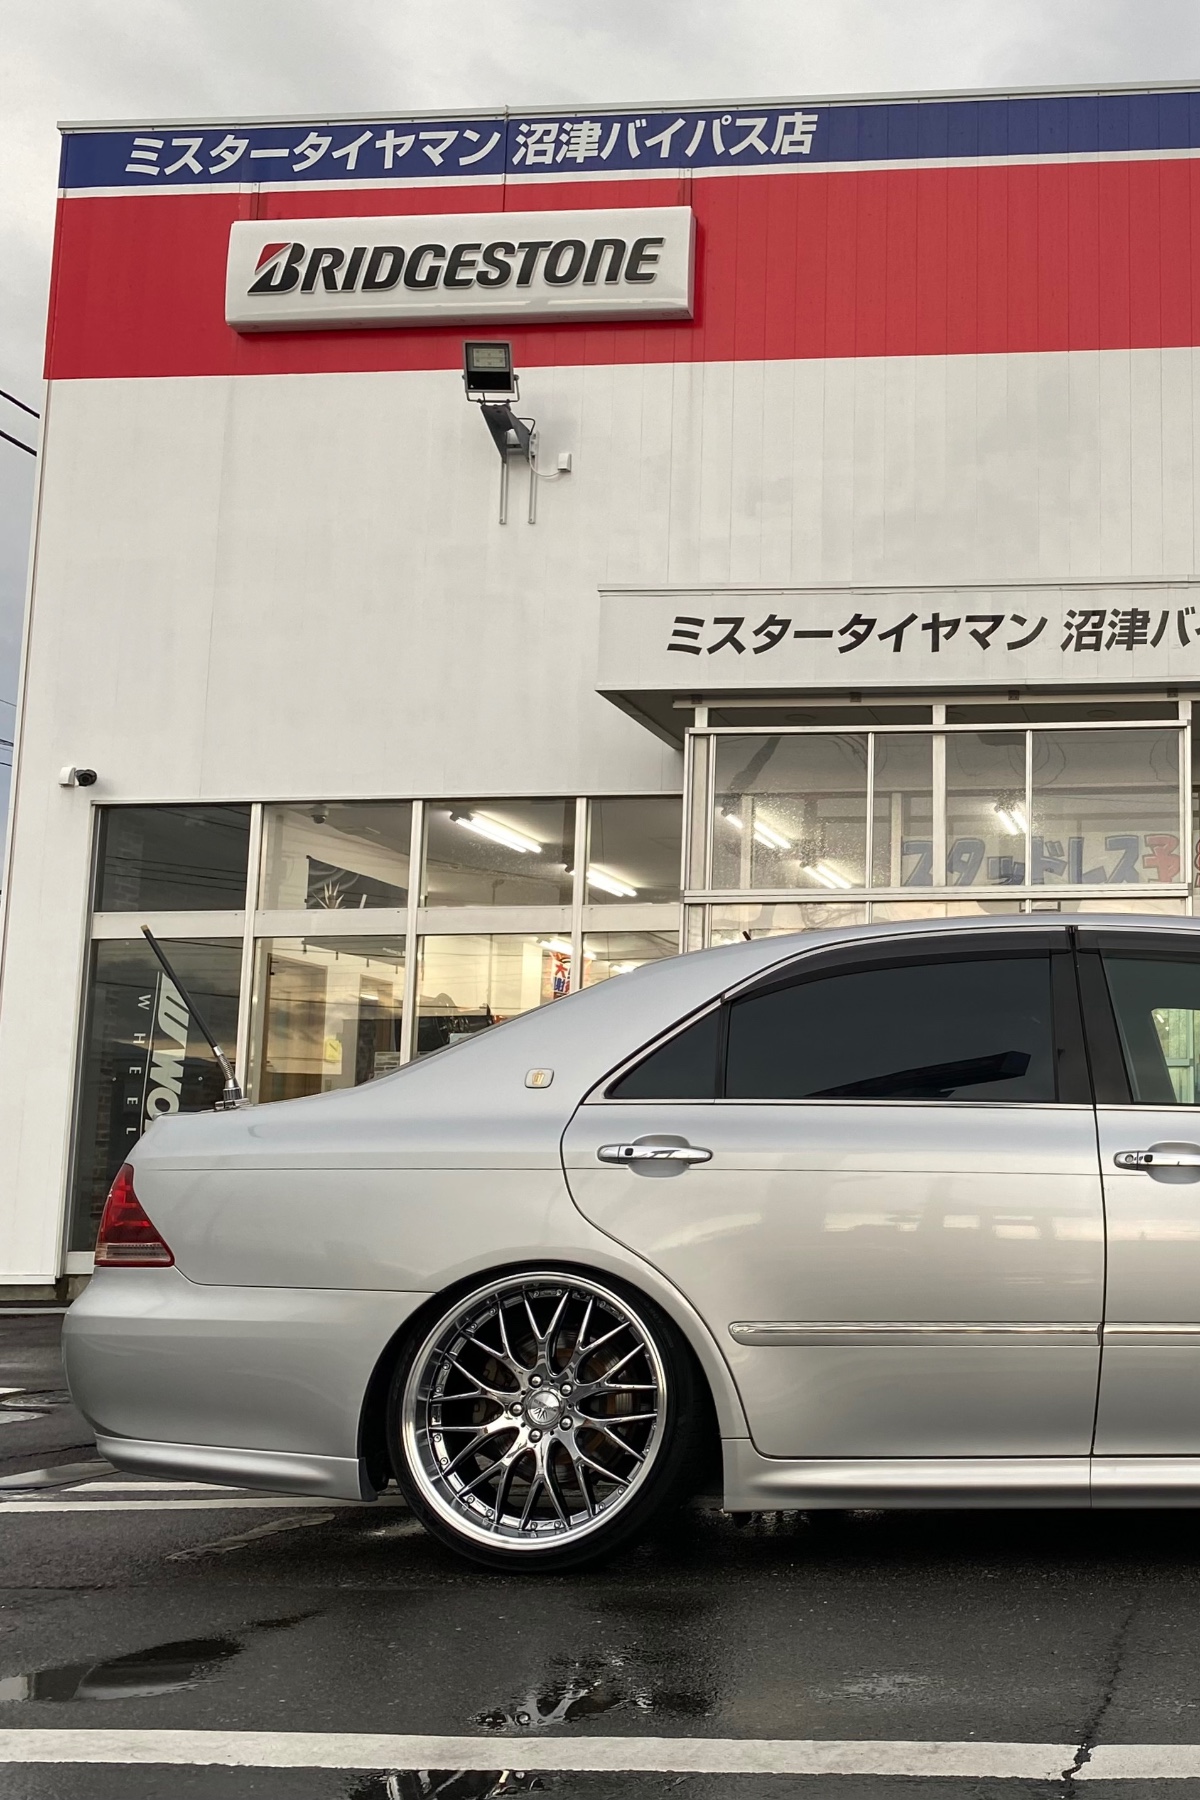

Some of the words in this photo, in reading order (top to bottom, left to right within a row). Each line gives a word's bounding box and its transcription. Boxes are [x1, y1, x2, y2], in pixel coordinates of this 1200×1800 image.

[125, 130, 500, 176] ミスタータイヤマン
[511, 113, 817, 165] 沼津バイパス店
[247, 236, 666, 297] BRIDGESTONE
[666, 612, 1049, 656] ミスタータイヤマン
